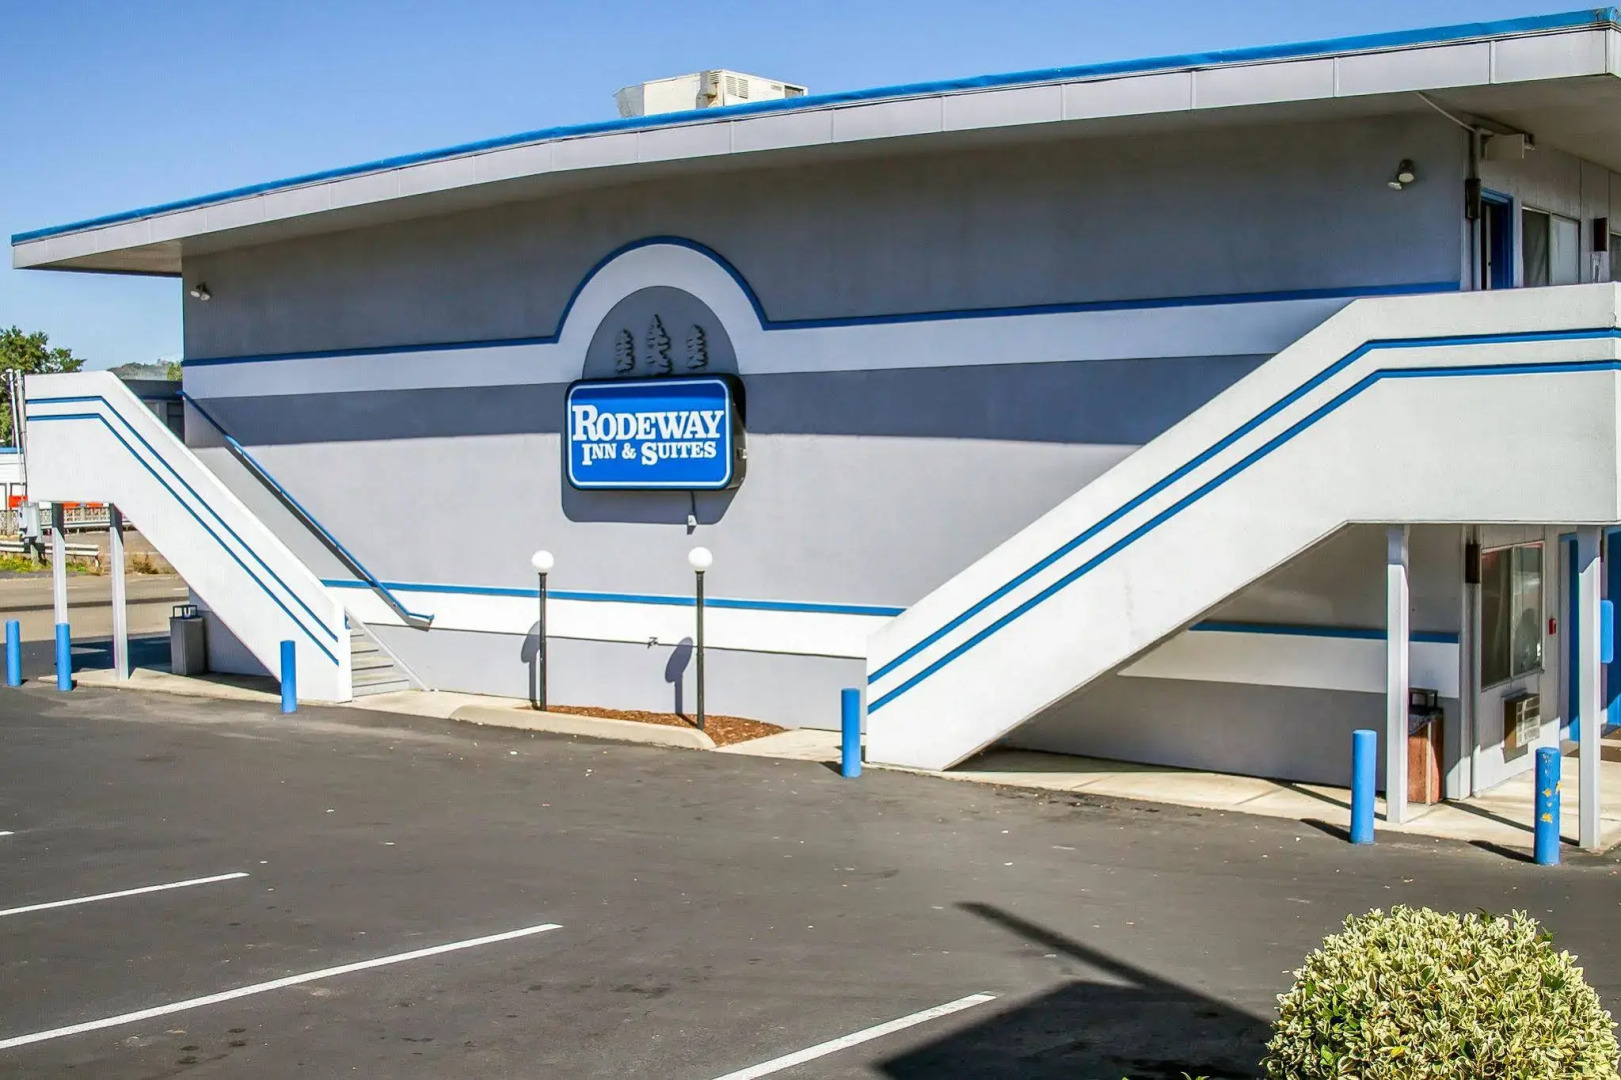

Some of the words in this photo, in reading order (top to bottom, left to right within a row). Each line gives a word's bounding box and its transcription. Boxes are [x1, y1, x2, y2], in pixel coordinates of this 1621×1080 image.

[572, 405, 724, 441] RODEWAY
[582, 443, 617, 465] INN
[622, 443, 636, 459] &
[641, 441, 716, 465] SUITES
